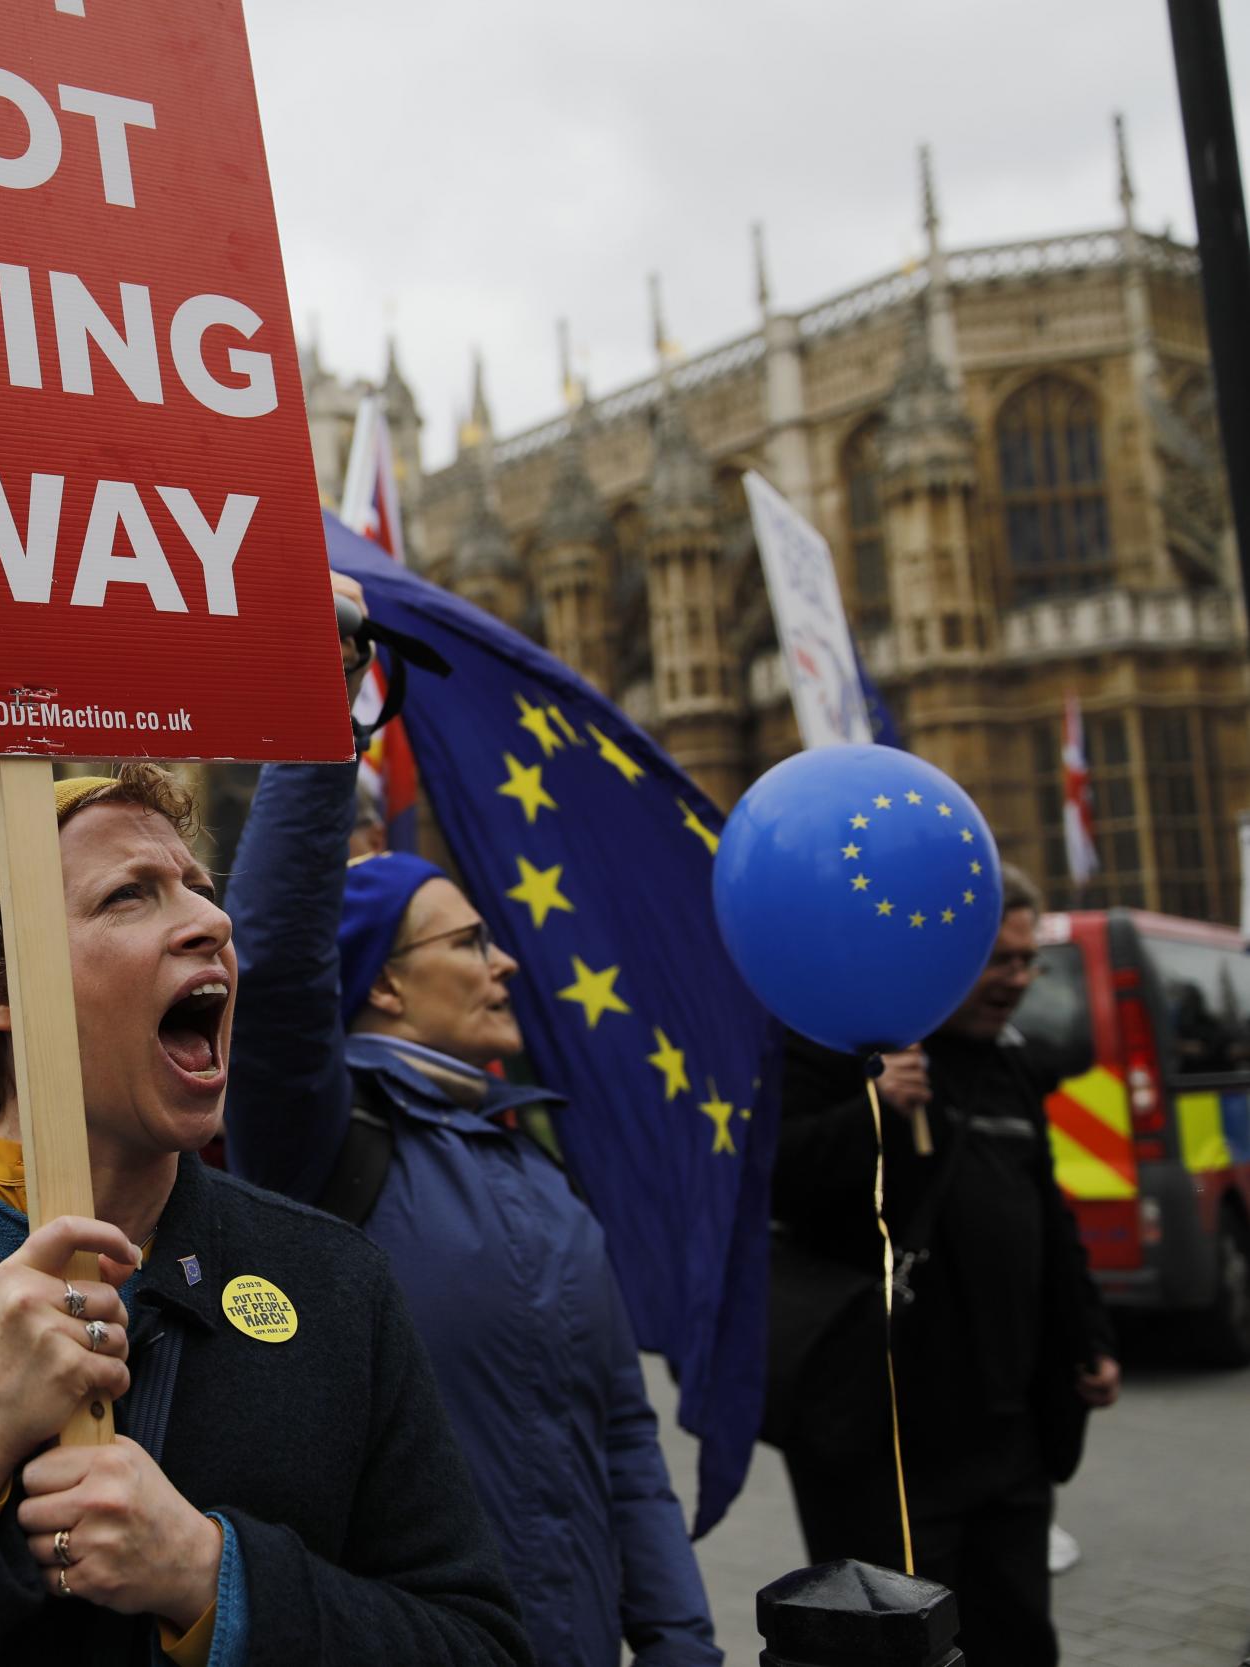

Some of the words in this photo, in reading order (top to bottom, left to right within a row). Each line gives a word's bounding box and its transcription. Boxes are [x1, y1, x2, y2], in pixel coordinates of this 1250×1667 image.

[232, 1294, 252, 1305] PUT
[254, 1293, 264, 1302] IT
[265, 1292, 277, 1301] TO
[227, 1304, 251, 1317] THE
[252, 1302, 291, 1312] PEOPLE
[243, 1312, 288, 1327] MARCH
